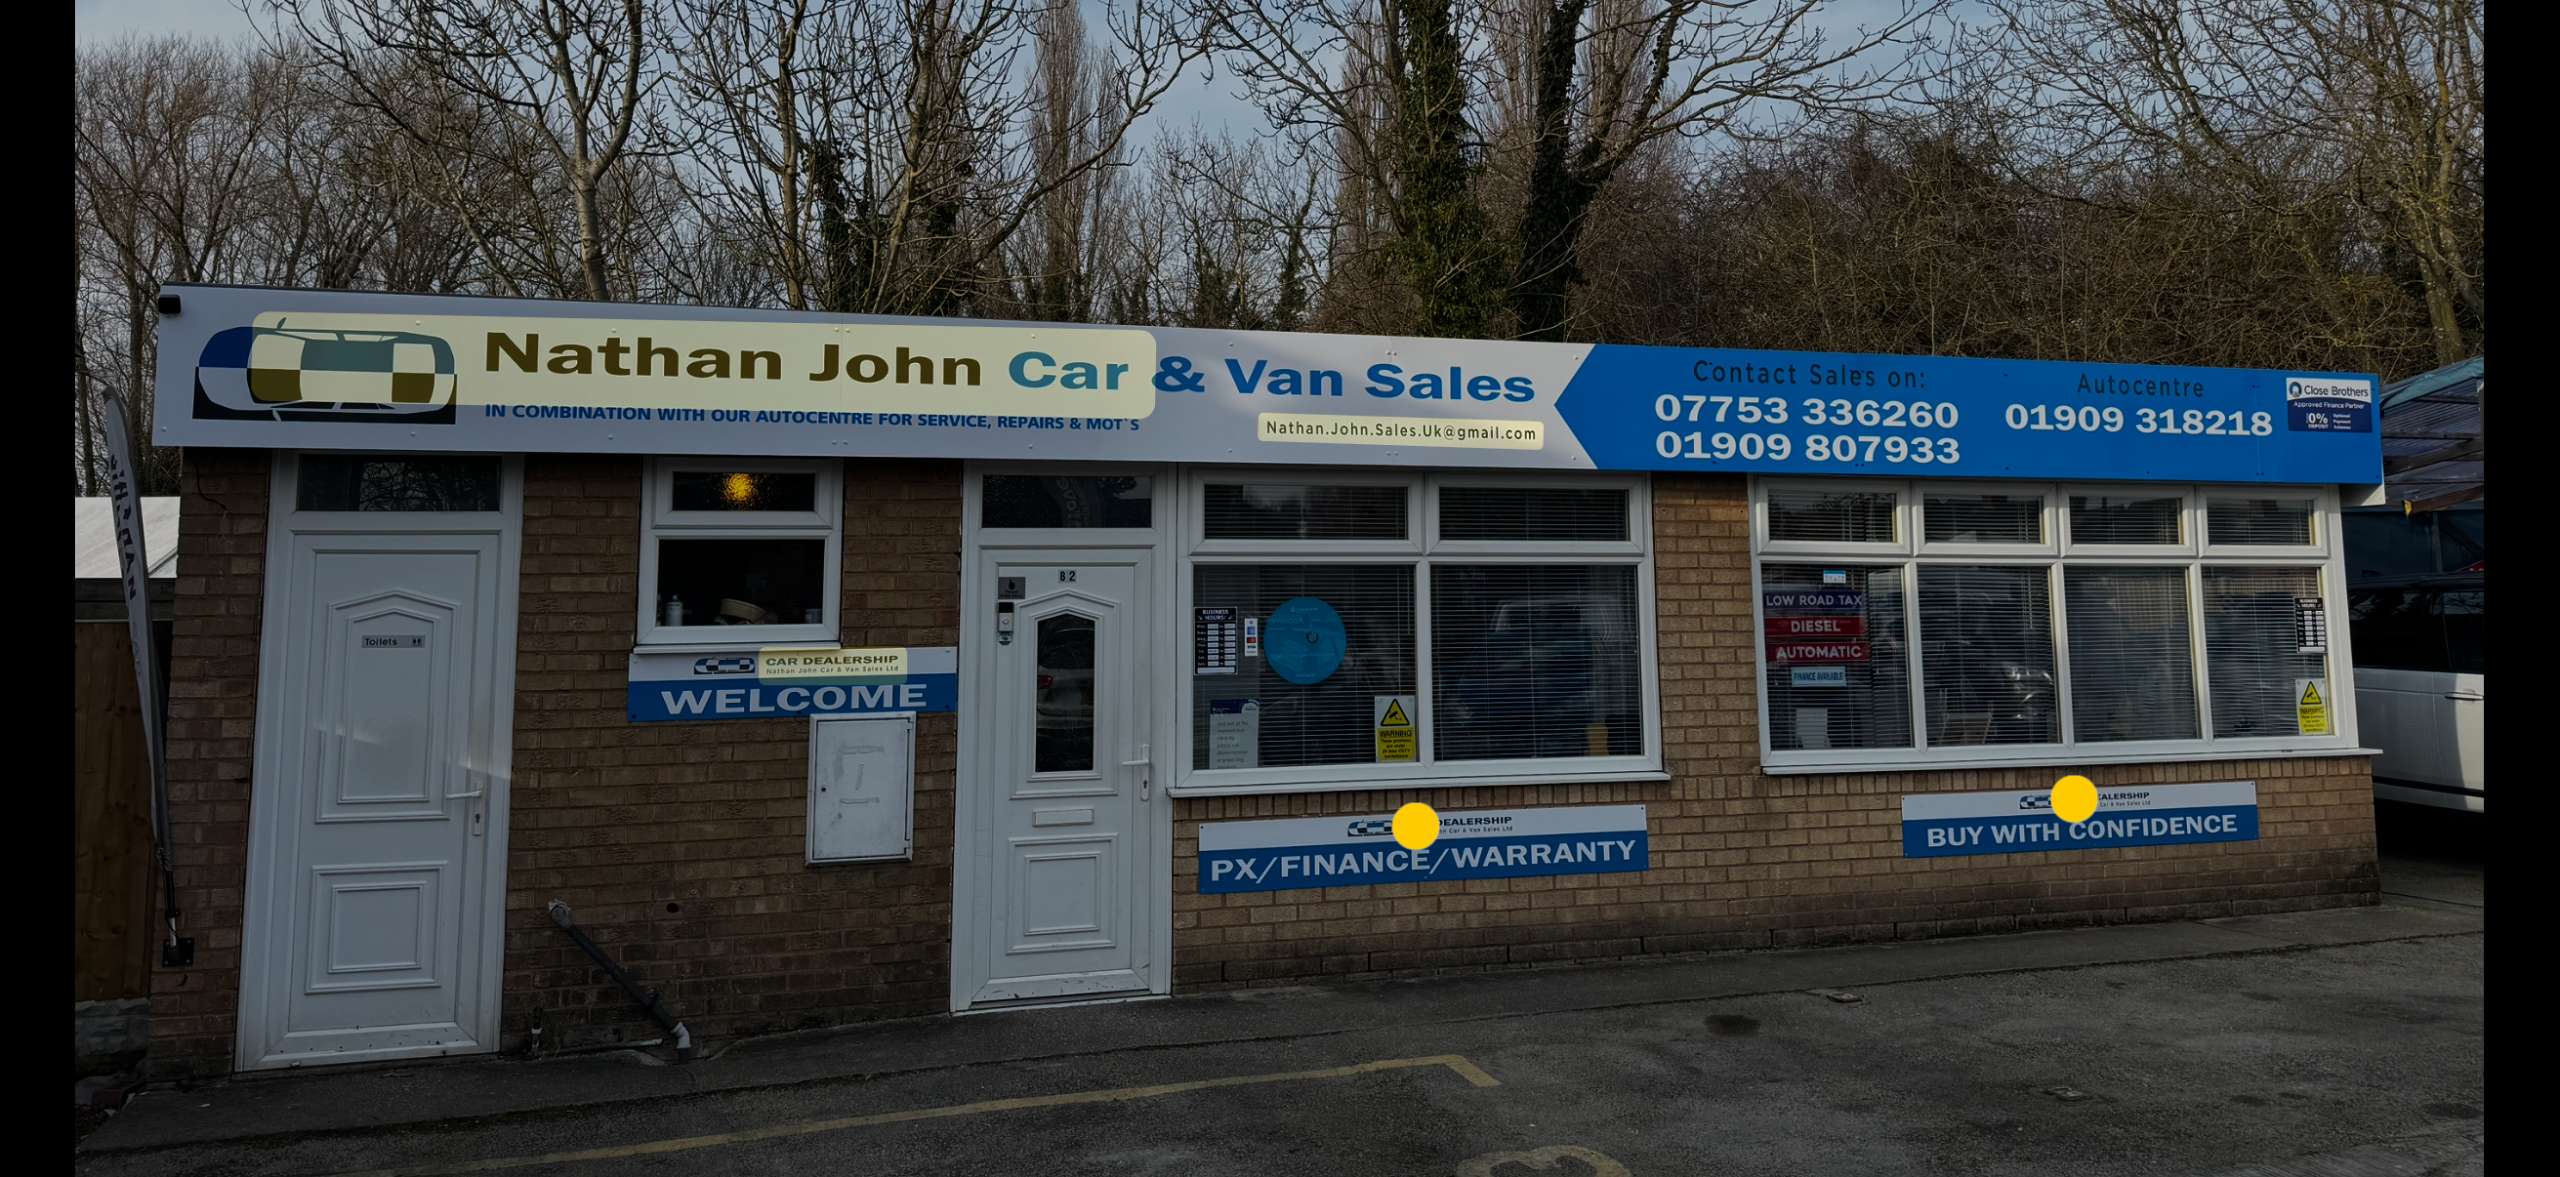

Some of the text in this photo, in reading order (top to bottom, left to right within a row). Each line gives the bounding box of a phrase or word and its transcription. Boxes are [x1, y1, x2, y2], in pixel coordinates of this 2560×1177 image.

[486, 332, 1535, 402] Nathan John Car & Van Sales
[1693, 360, 1926, 389] Contact Sales on:
[2077, 373, 2204, 398] Autocentre
[2304, 385, 2369, 397] Close Brothers
[485, 404, 506, 417] IN
[512, 404, 651, 421] COMBINATION
[657, 407, 705, 422] WITH
[711, 409, 750, 423] OUR
[755, 410, 873, 425] AUTOCENTRE
[879, 413, 913, 426] FOR
[918, 414, 993, 429] SERVICE,
[998, 416, 1065, 429] REPAIRS
[1070, 417, 1081, 430] &
[1655, 394, 1960, 429] 07753 336260
[2005, 403, 2273, 437] 01909 318218
[1266, 421, 1537, 441] Nathan.John.Sales.Uk@gmail.com
[1656, 431, 1961, 465] 01909 807933
[1766, 594, 1862, 607] LOW ROAD TAX
[1790, 620, 1841, 633] DIESEL
[365, 638, 397, 646] Toilets
[1775, 645, 1862, 659] AUTOMATIC
[766, 655, 899, 666] CAR DEALERSHIP
[661, 683, 928, 715] WELCOME
[2098, 791, 2150, 801] ALERSHIP
[1927, 814, 2238, 849] BUY WITH CONFIDENCE
[1211, 840, 1636, 883] PX/FINANCE/WARRANTY
